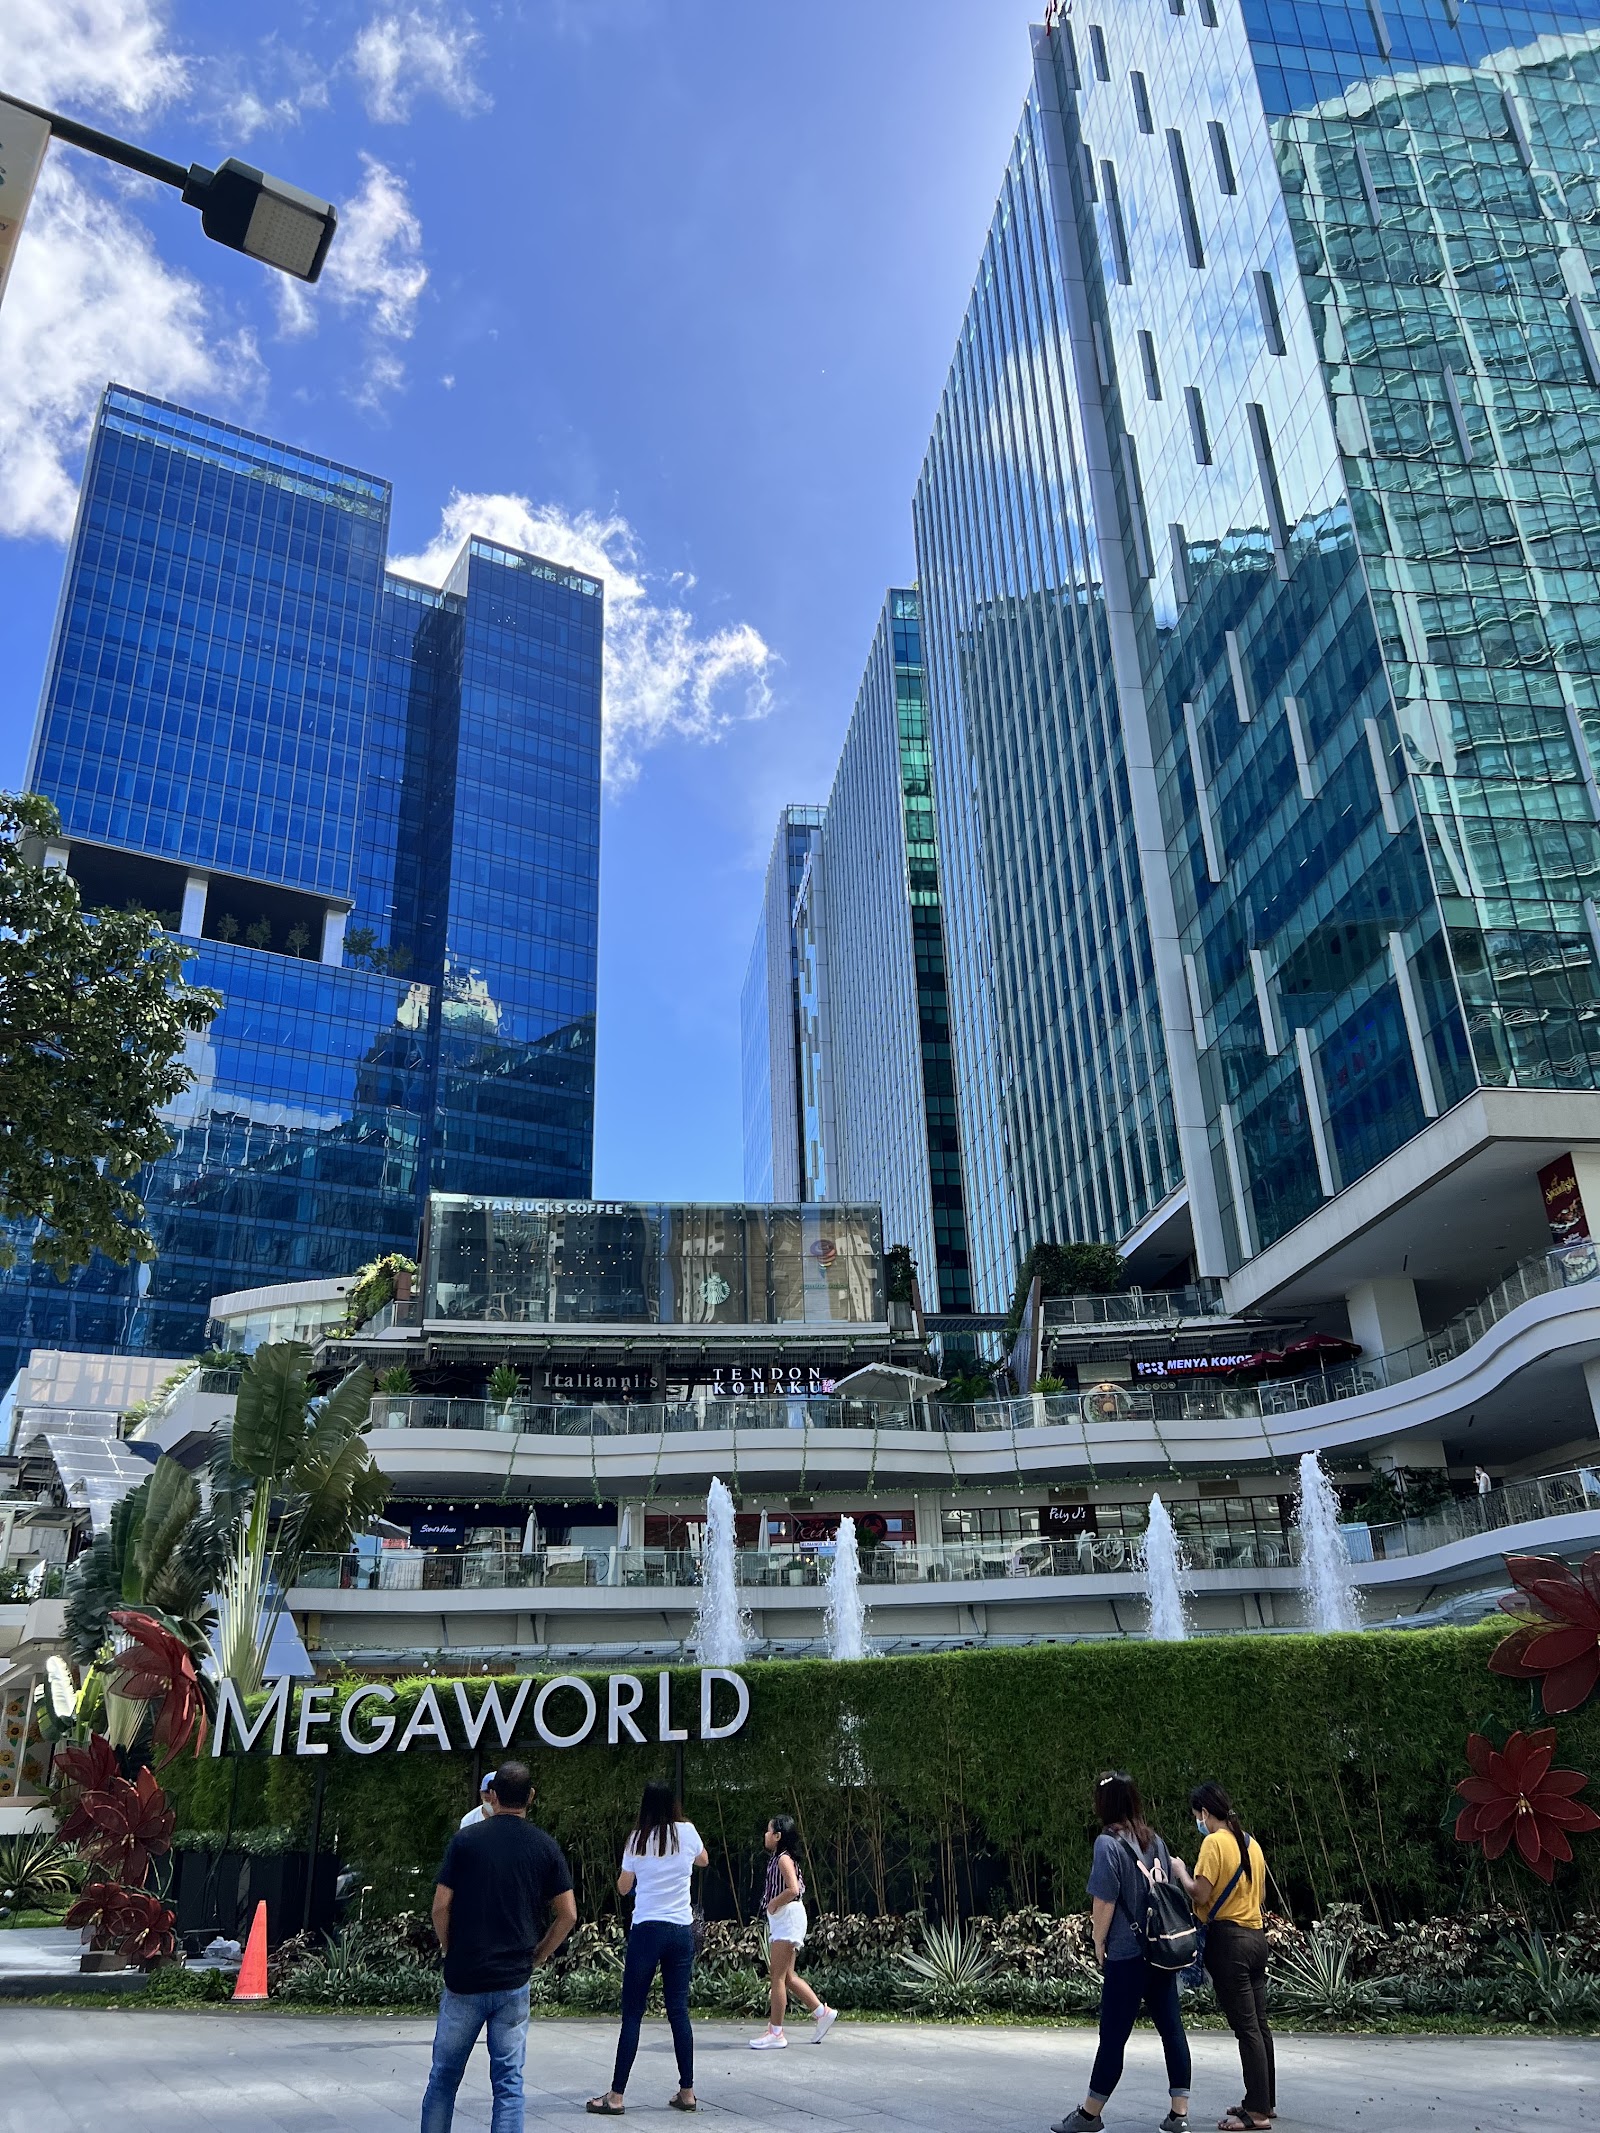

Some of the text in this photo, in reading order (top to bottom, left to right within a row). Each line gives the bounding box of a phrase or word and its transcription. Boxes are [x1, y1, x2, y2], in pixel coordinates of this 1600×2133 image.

[473, 1200, 623, 1215] STARBUCKS COFFEE
[1167, 1357, 1208, 1370] MENYA
[713, 1367, 820, 1380] TENDON
[714, 1381, 821, 1394] KOHAKU
[1071, 1506, 1086, 1519] J's
[211, 1668, 751, 1758] MEGAWORLD
